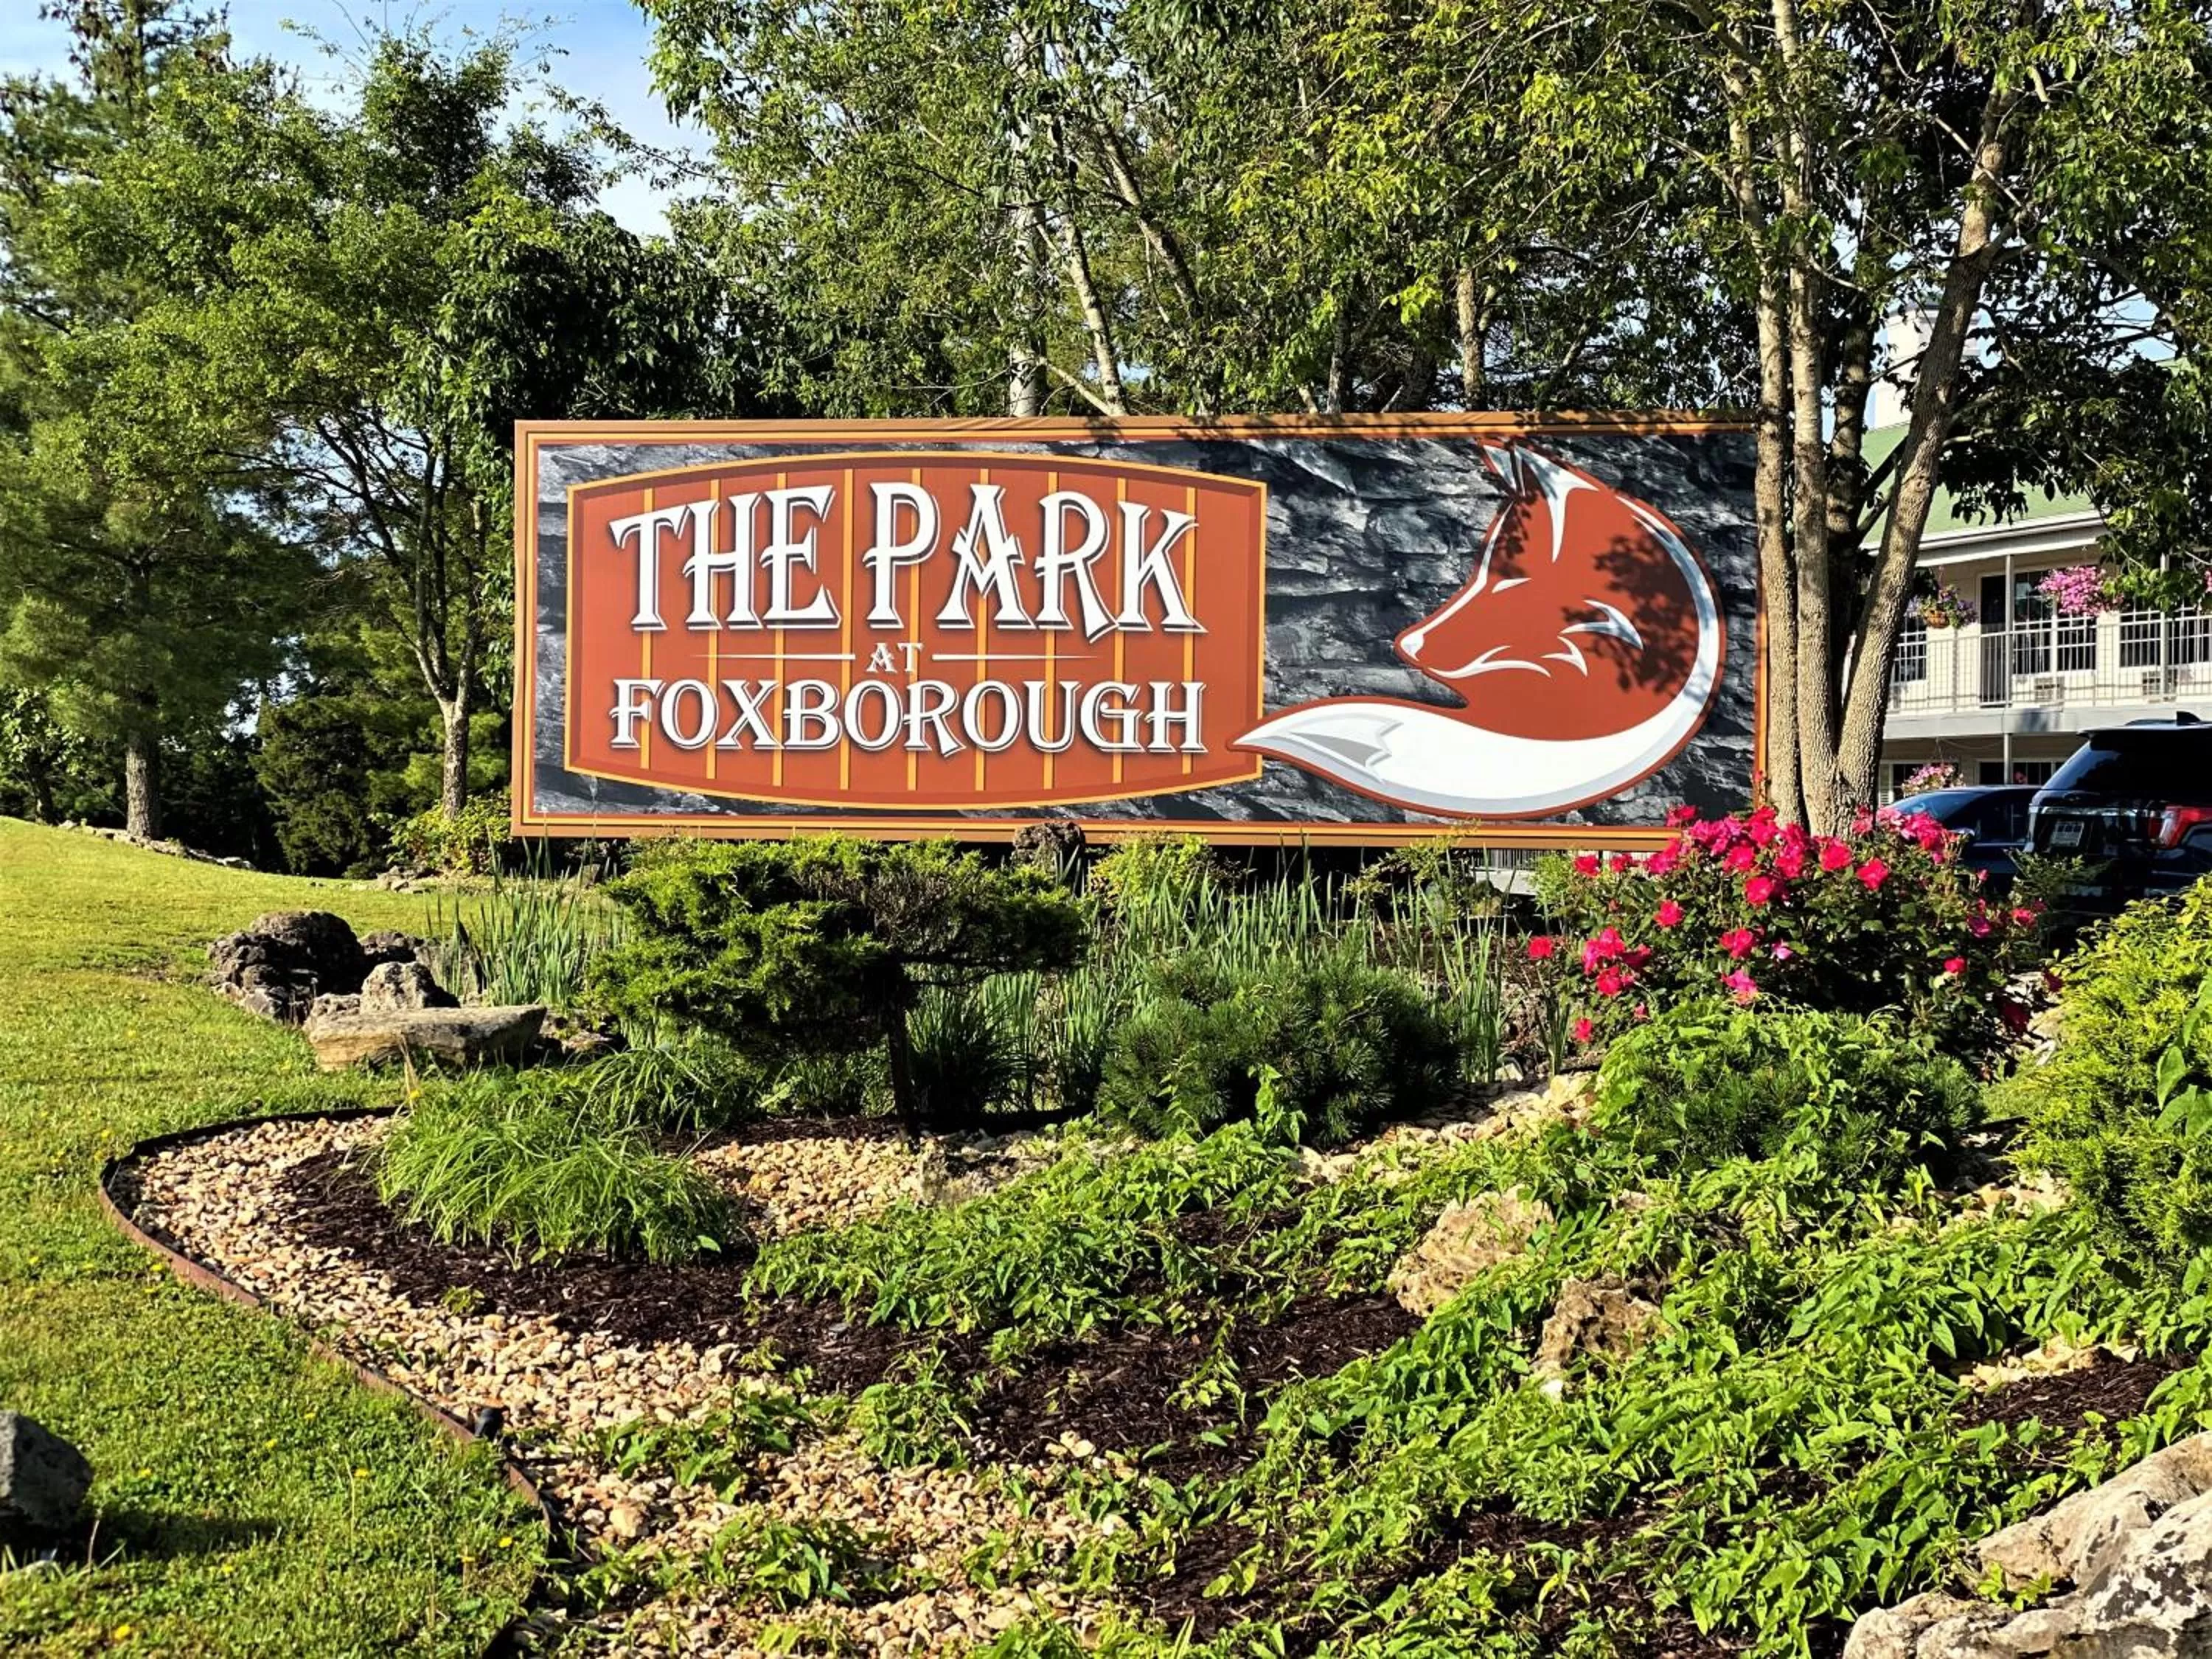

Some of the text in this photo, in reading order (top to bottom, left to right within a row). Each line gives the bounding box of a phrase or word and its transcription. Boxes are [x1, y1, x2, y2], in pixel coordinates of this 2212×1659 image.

[608, 481, 1208, 644] THE PARK
[866, 641, 923, 673] AT
[608, 678, 1208, 758] FOXBOROUGH
